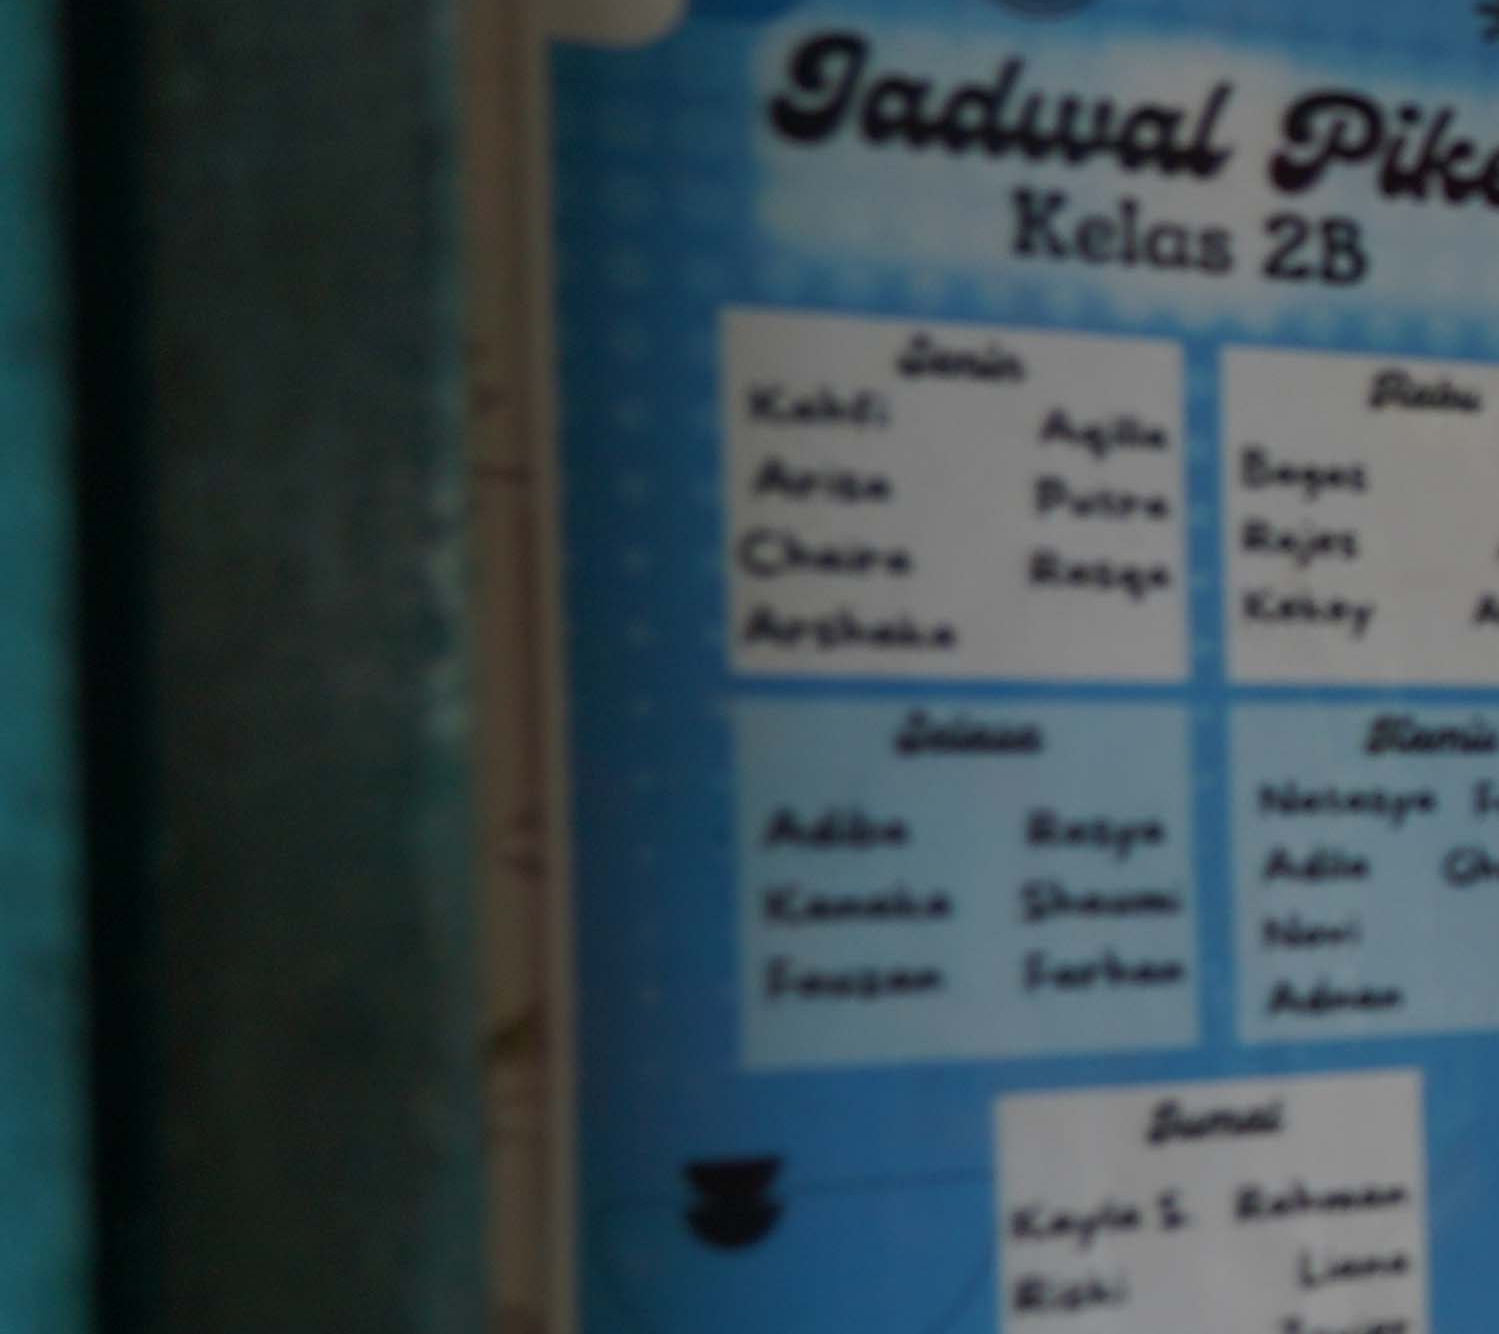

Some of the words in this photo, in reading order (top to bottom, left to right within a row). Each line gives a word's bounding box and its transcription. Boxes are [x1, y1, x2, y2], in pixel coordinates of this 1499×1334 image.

[771, 33, 1229, 177] Jadwal
[1013, 189, 1232, 272] Kelas
[1264, 217, 1366, 283] 2B
